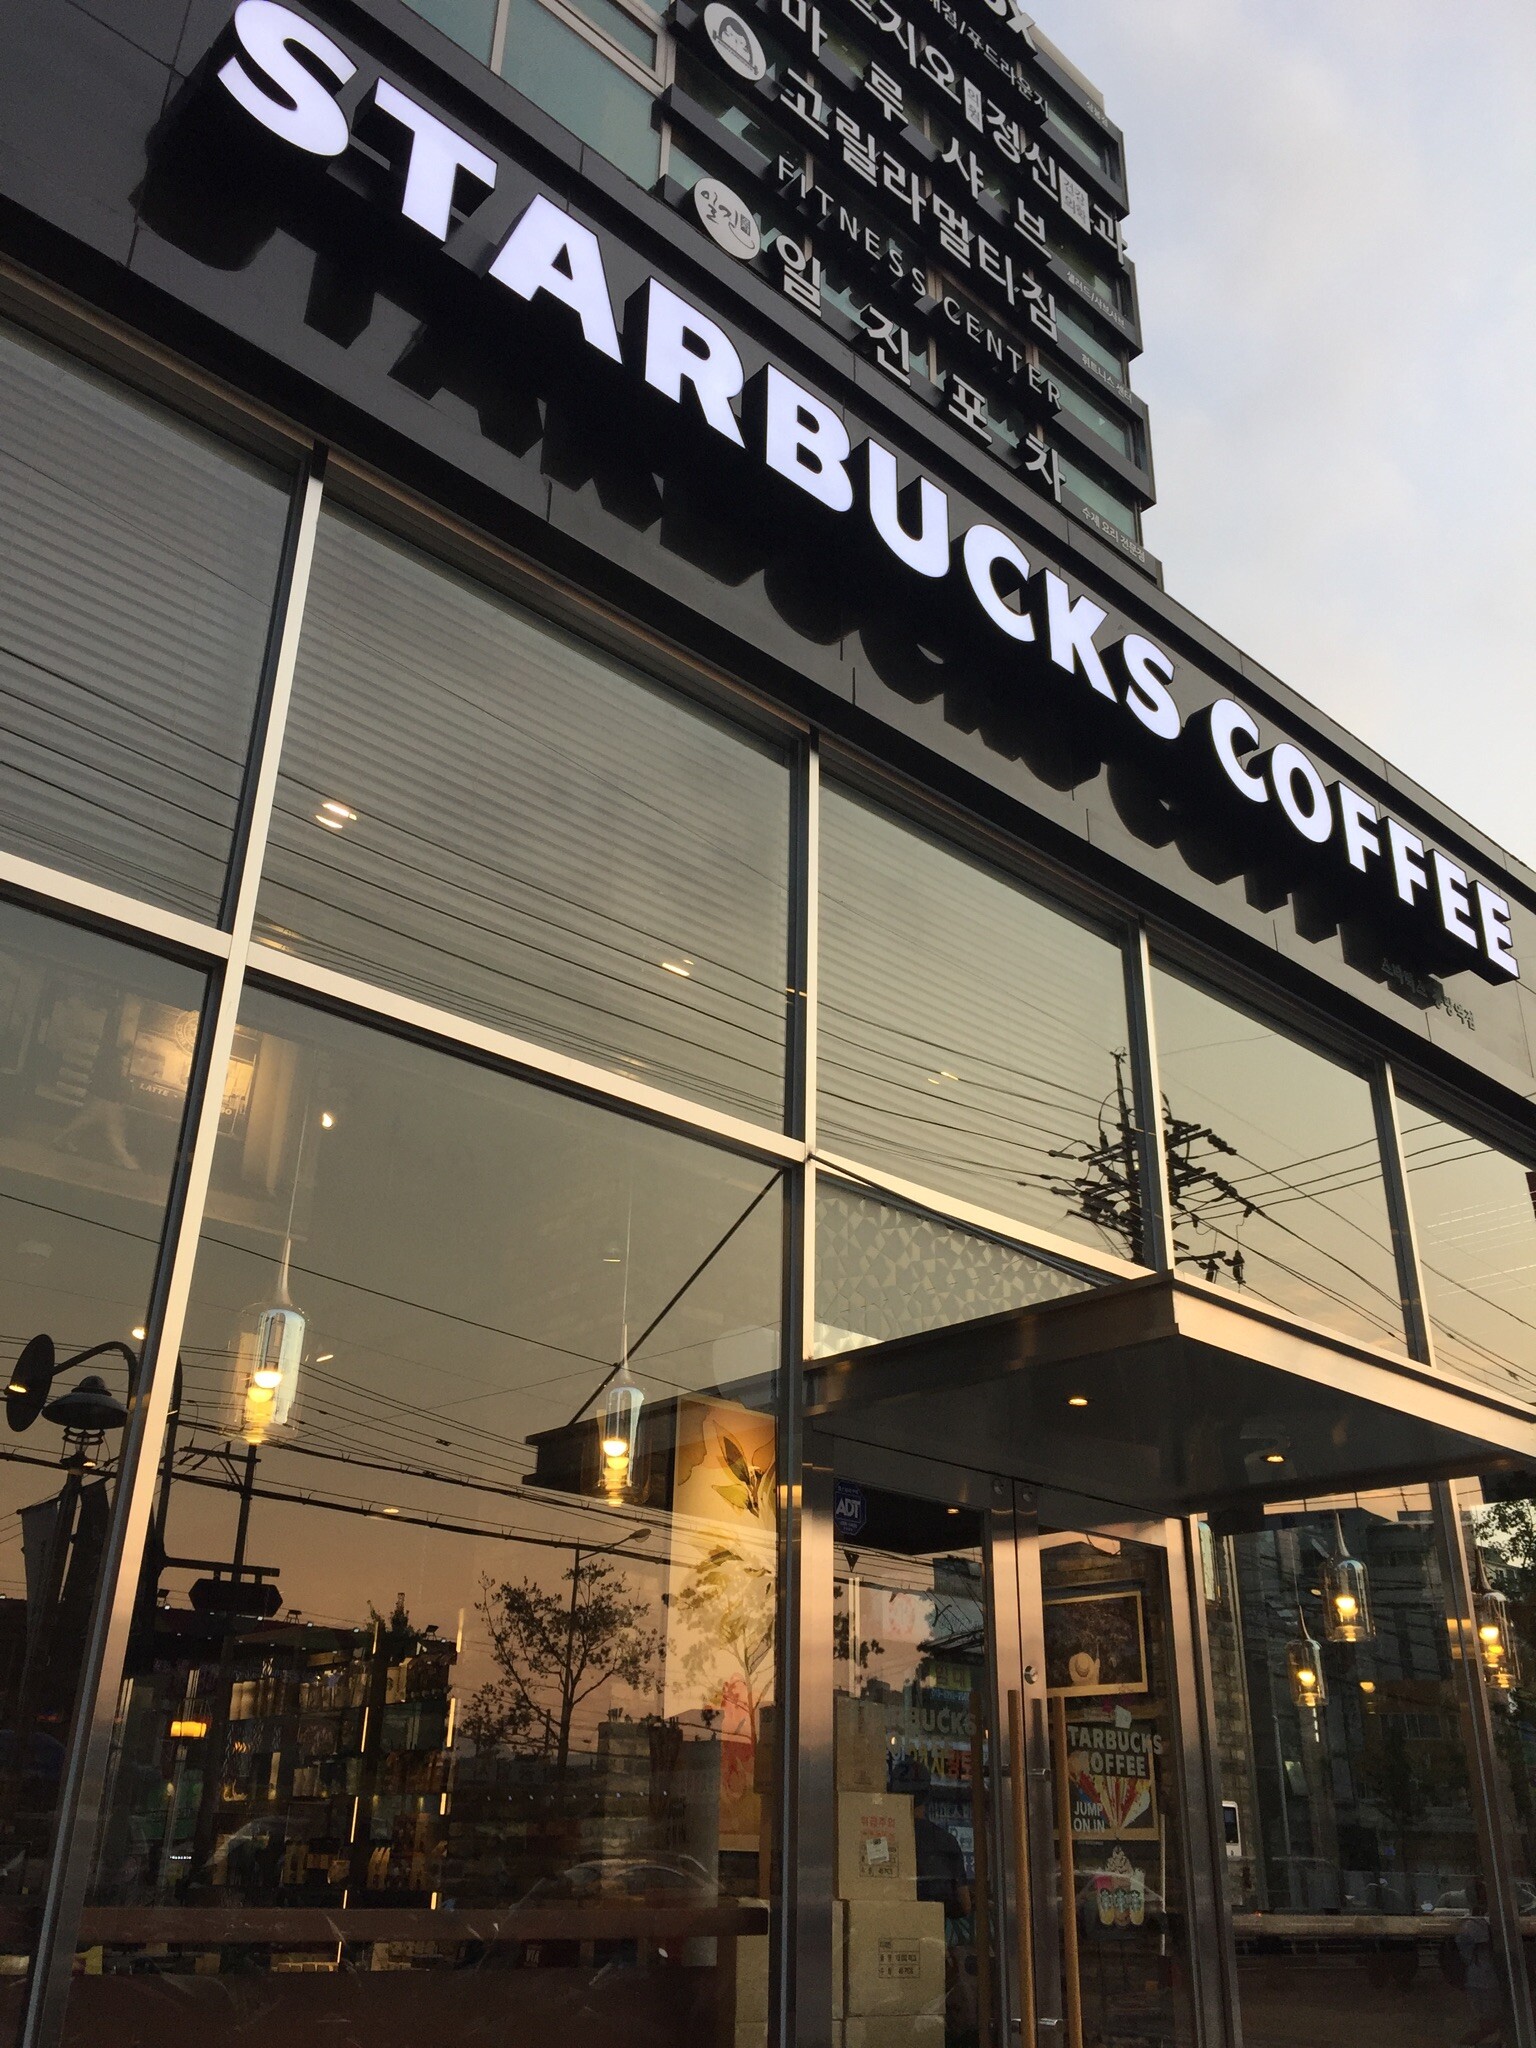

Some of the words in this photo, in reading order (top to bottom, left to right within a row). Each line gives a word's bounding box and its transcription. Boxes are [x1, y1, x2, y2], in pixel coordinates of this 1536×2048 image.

[781, 0, 1052, 260] 마루샤브
[985, 98, 1060, 203] 정신
[780, 67, 1059, 343] 고릴라멀티짐
[1093, 203, 1128, 265] 과
[777, 155, 929, 297] FITNESS
[942, 296, 1062, 412] CENTER
[776, 235, 1067, 503] 일진포차
[217, 0, 1182, 740] STARBUCKS
[1211, 698, 1520, 979] COFFEE
[1082, 507, 1100, 528] 수제
[1101, 521, 1119, 543] 요리
[1120, 534, 1146, 563] 전문점
[139, 1083, 169, 1097] LATTE
[835, 1496, 862, 1519] ADT
[1067, 1724, 1163, 1755] TARBUCKS
[1073, 1800, 1103, 1817] JUMP
[1073, 1817, 1091, 1833] ON
[1092, 1818, 1106, 1834] IN
